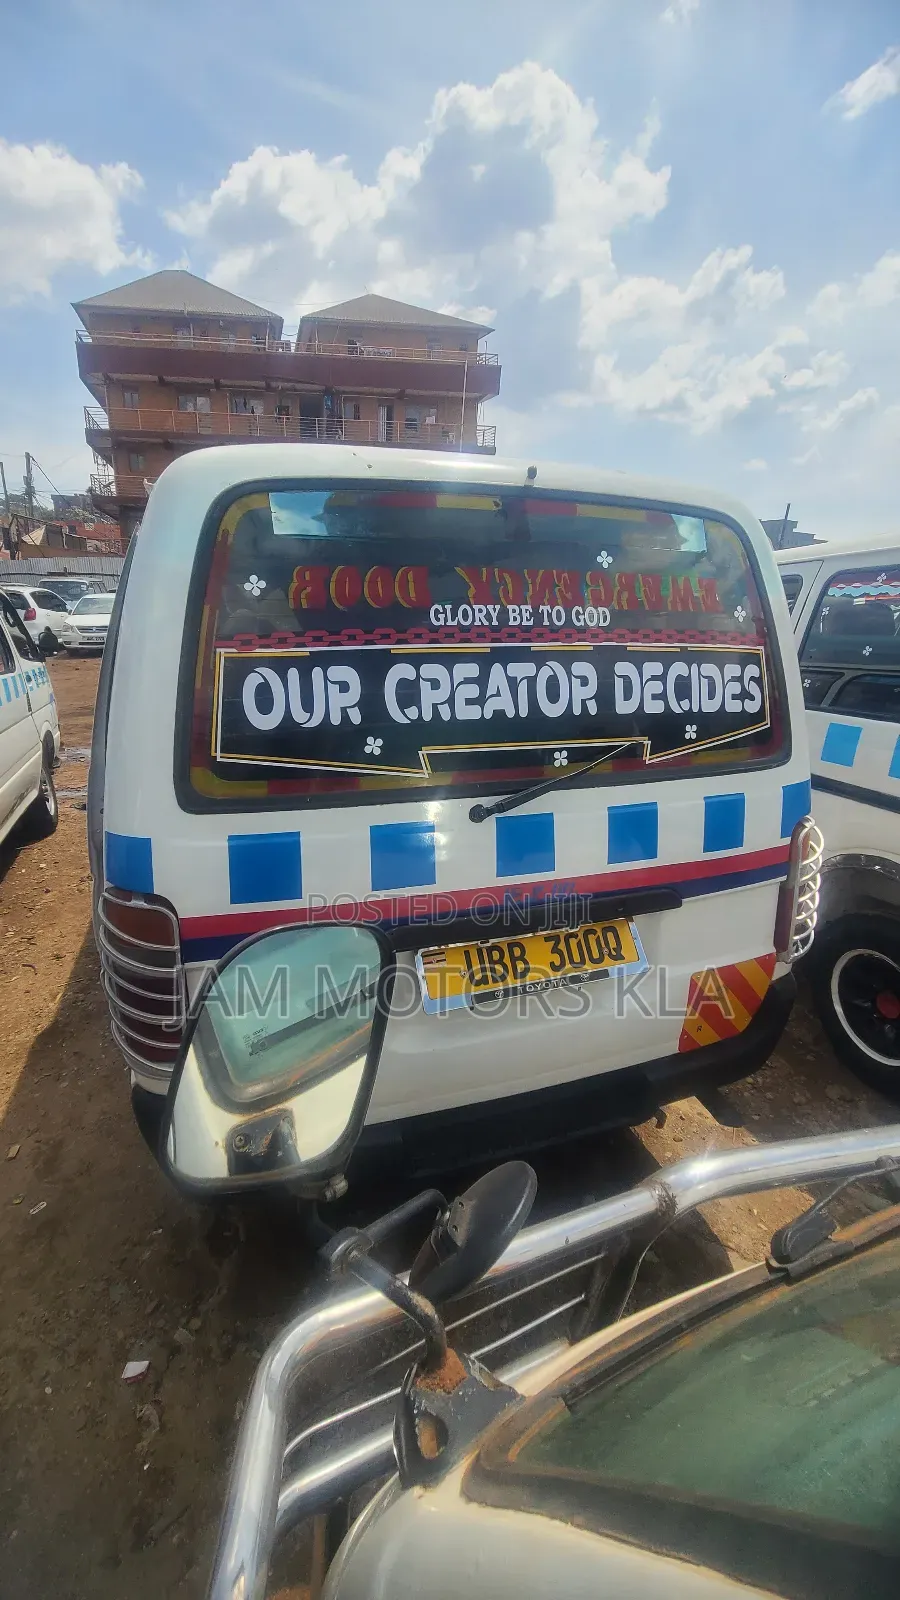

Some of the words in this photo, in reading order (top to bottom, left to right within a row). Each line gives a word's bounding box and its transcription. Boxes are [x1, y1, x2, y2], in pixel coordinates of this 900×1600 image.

[429, 604, 500, 627] GLORY
[506, 604, 534, 626] BE
[539, 605, 566, 626] TO
[571, 606, 611, 627] GOD
[241, 665, 362, 731] OUR
[384, 661, 598, 723] CREATOR
[615, 663, 761, 714] DECIDES
[463, 941, 531, 987] UBB
[544, 925, 626, 973] 300Q
[518, 978, 567, 993] TOYOTA
